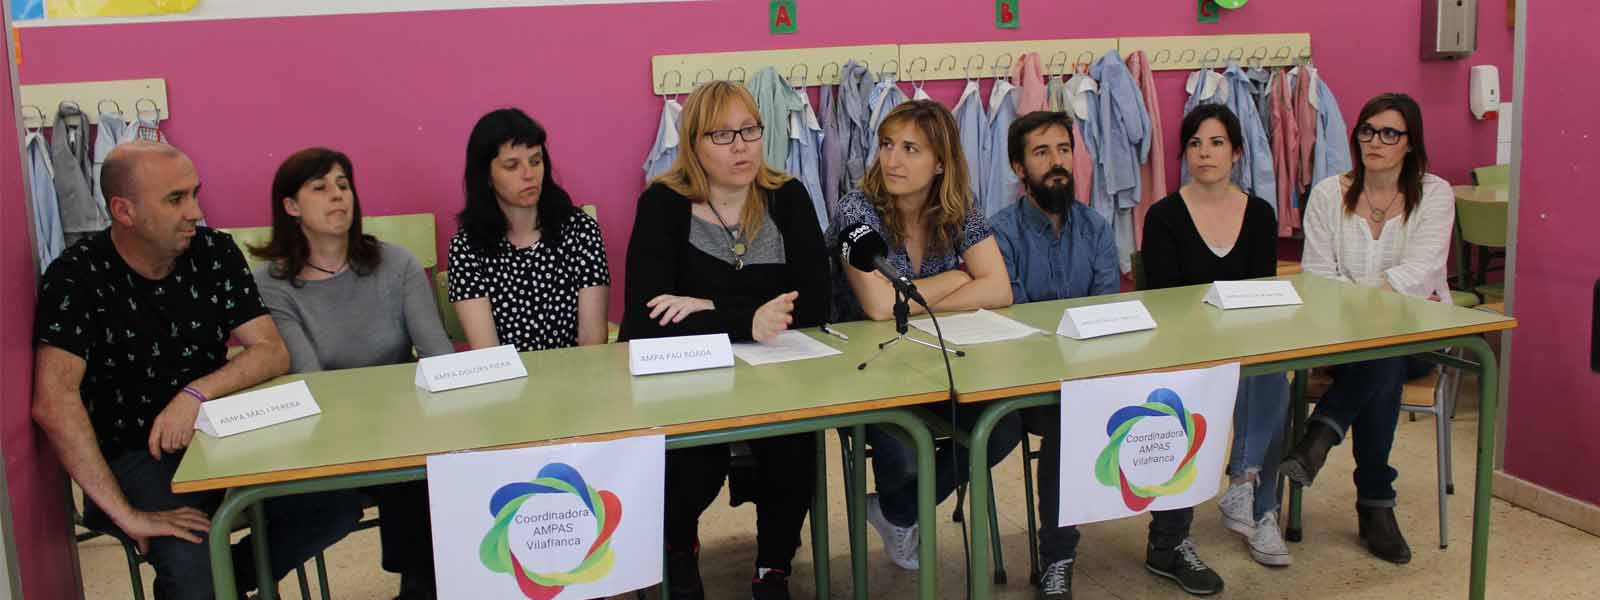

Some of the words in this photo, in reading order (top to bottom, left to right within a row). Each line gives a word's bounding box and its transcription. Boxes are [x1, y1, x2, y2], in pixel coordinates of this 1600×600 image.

[1001, 2, 1013, 24] B
[1201, 0, 1213, 17] C
[775, 5, 792, 27] A
[220, 414, 246, 425] AMPA
[1126, 430, 1183, 443] Coordinadora
[1139, 442, 1171, 453] AMPAS
[1133, 455, 1174, 467] Vilafranca
[515, 509, 589, 524] Coordinadora
[533, 523, 574, 536] AMPAS
[526, 538, 581, 550] Vilafranca
